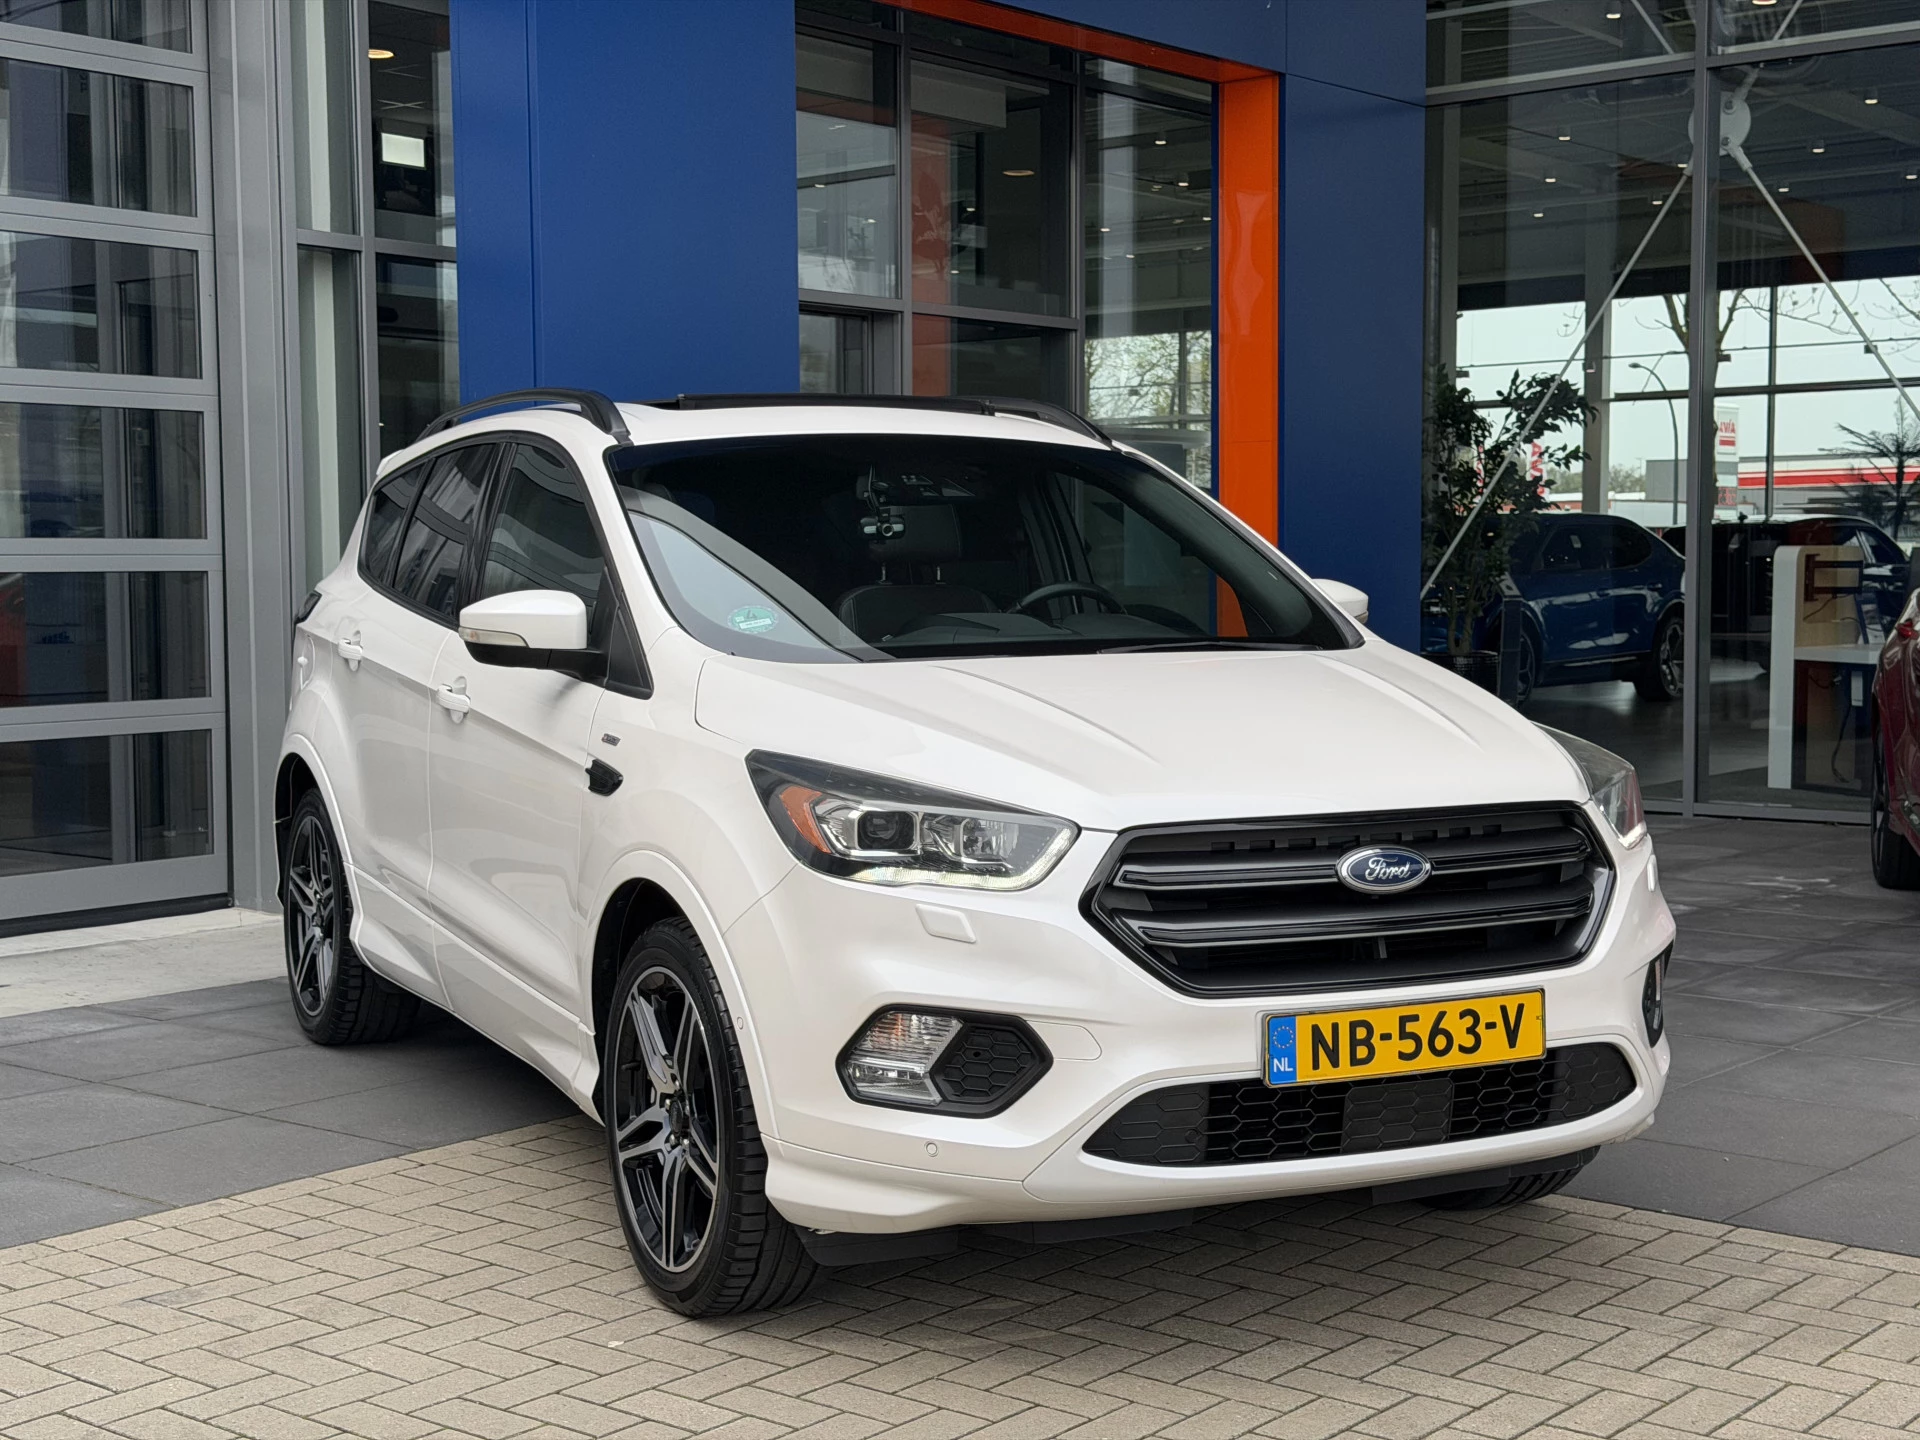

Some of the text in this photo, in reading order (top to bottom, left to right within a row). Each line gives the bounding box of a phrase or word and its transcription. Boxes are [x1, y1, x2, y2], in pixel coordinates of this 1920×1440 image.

[1365, 857, 1411, 881] Ford
[1311, 1003, 1525, 1071] NB-563-V
[1273, 1057, 1294, 1073] NL
